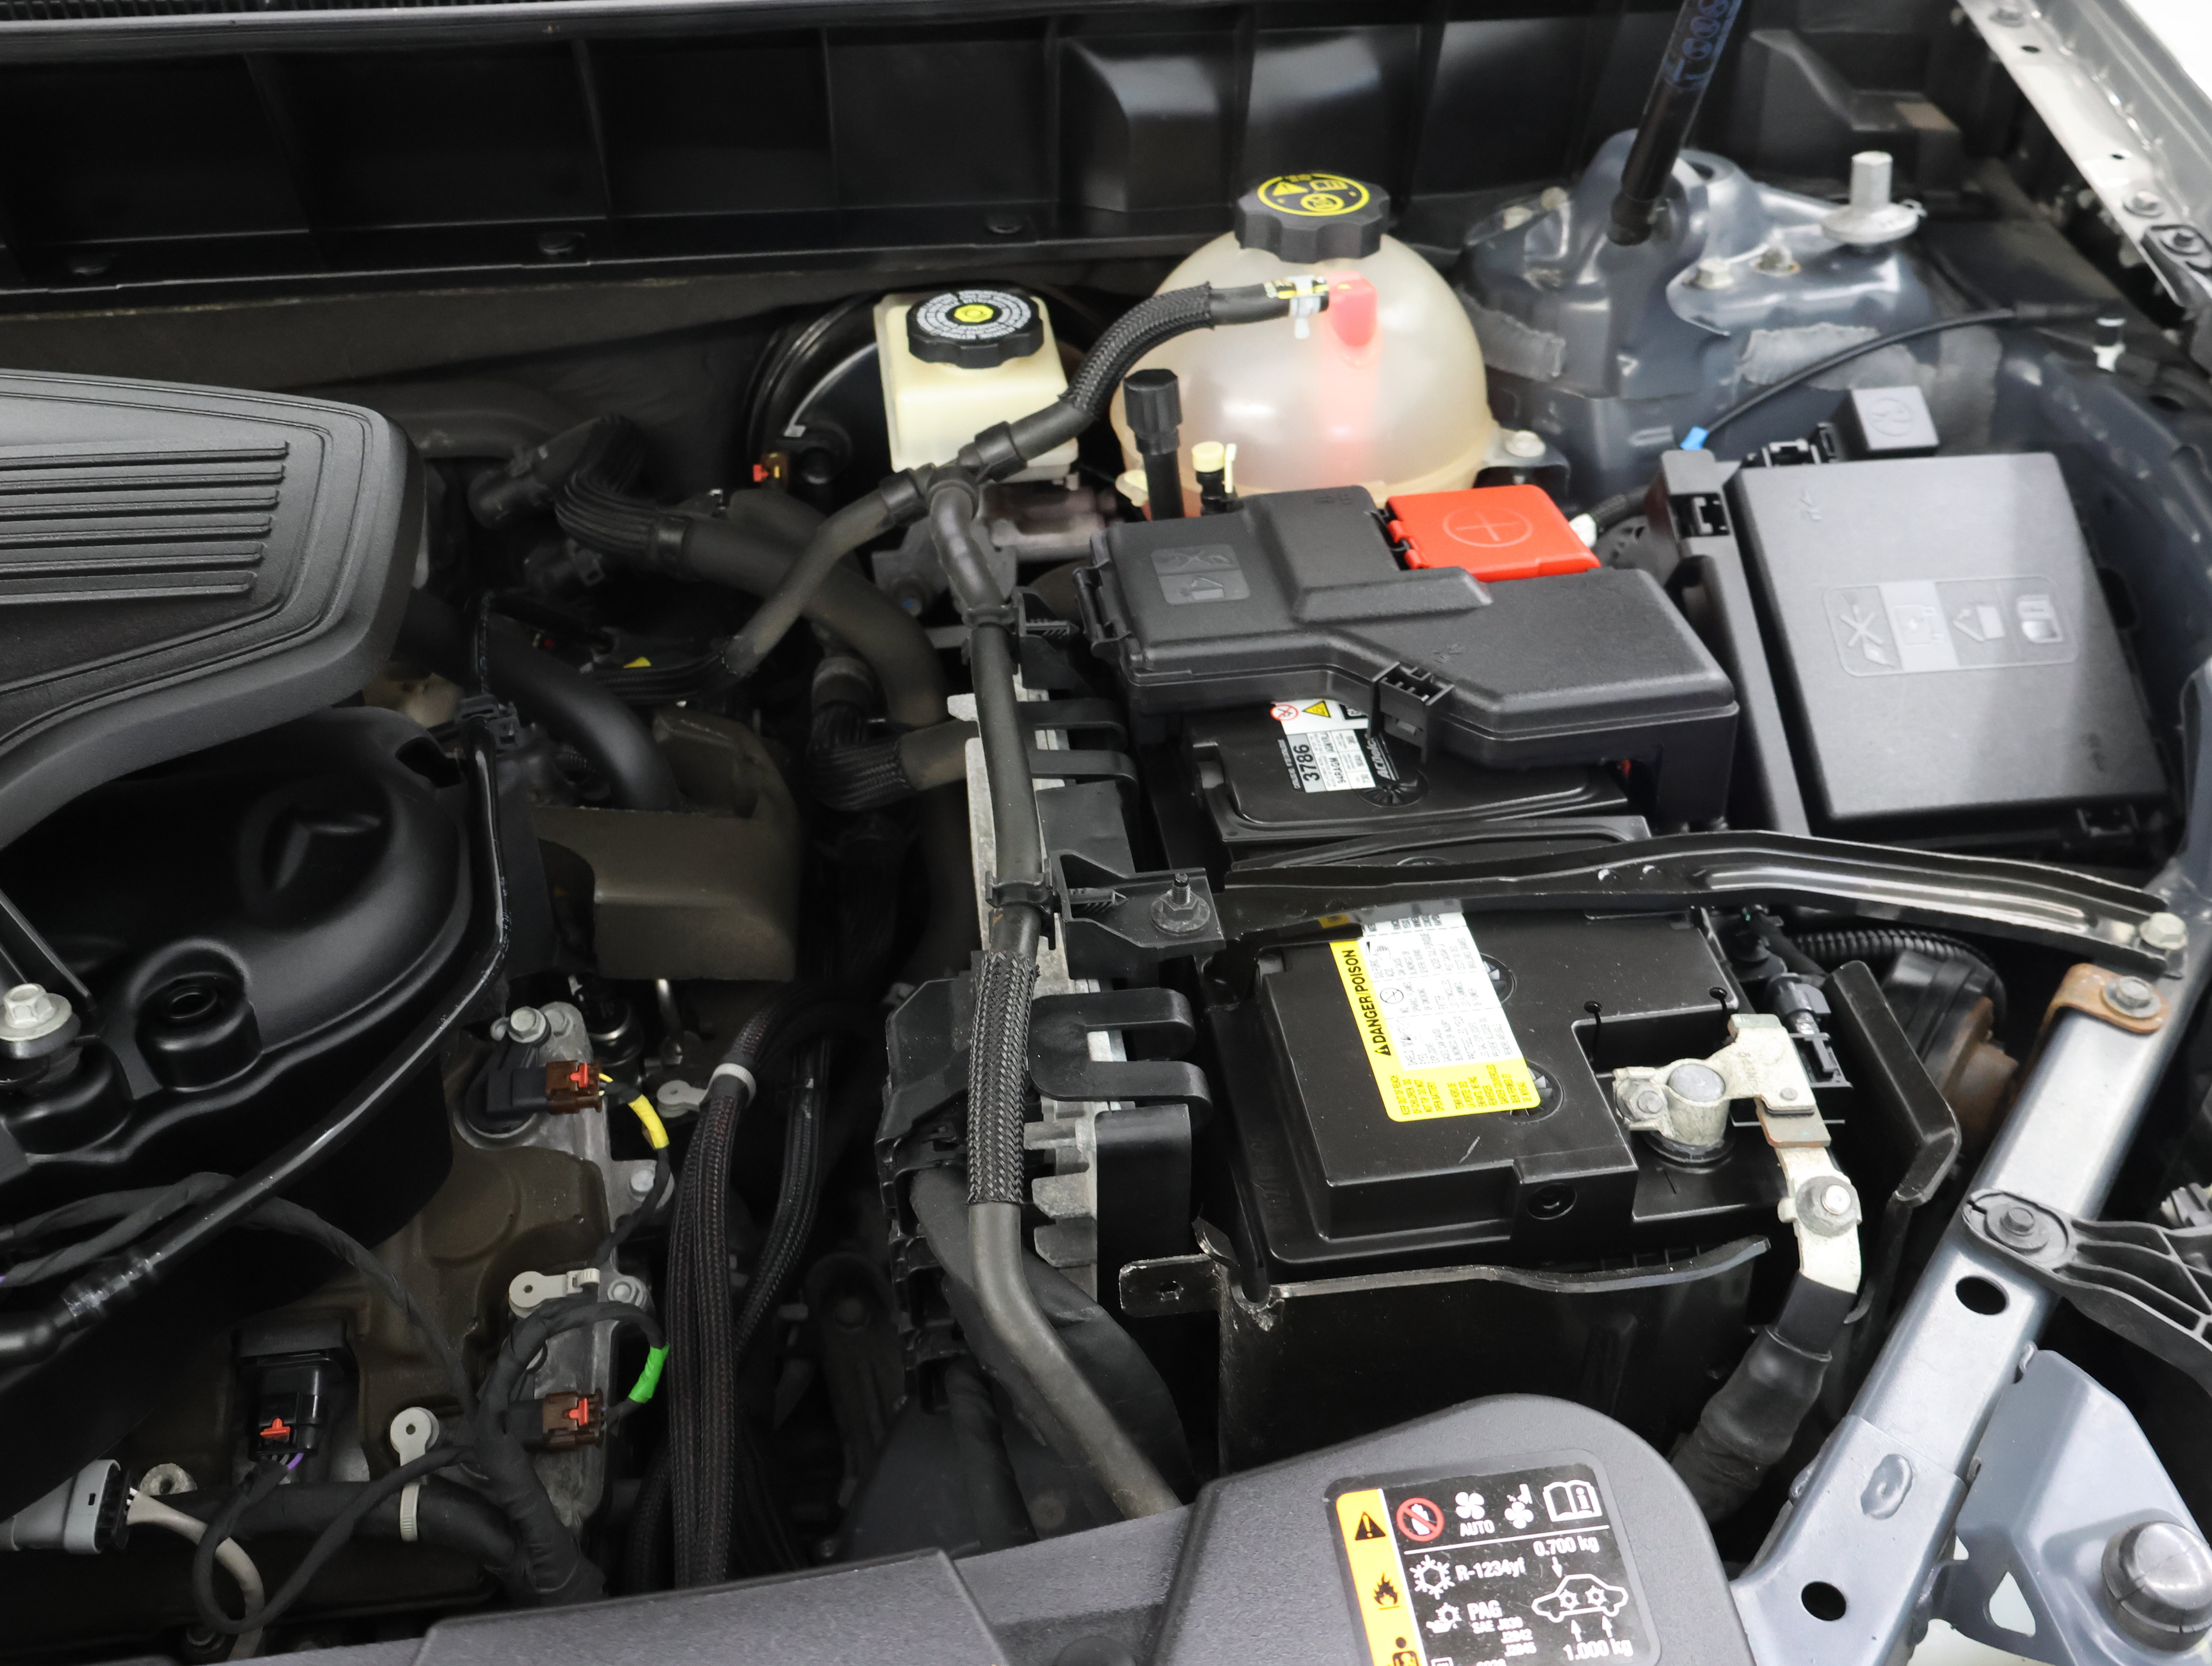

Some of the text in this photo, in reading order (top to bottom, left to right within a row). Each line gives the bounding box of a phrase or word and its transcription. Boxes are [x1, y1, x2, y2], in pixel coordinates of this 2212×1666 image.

[1293, 744, 1320, 781] 3786
[1364, 733, 1390, 780] ACDelc
[1329, 757, 1346, 783] 94RAGM
[1342, 949, 1385, 1043] DANGER/POISON
[1390, 1075, 1401, 1088] REACH
[1414, 1079, 1424, 1088] NOT
[1396, 1096, 1407, 1104] OUT
[1399, 1105, 1410, 1115] KEEP
[1422, 1104, 1432, 1112] NOT
[1460, 1520, 1495, 1536] AUTO
[1531, 1535, 1600, 1556] 0.700 kg
[1455, 1557, 1525, 1581] R-1234yf
[1467, 1600, 1504, 1622] PAG
[1472, 1616, 1524, 1634] SAE J639
[1563, 1637, 1634, 1661] 1.000 kg
